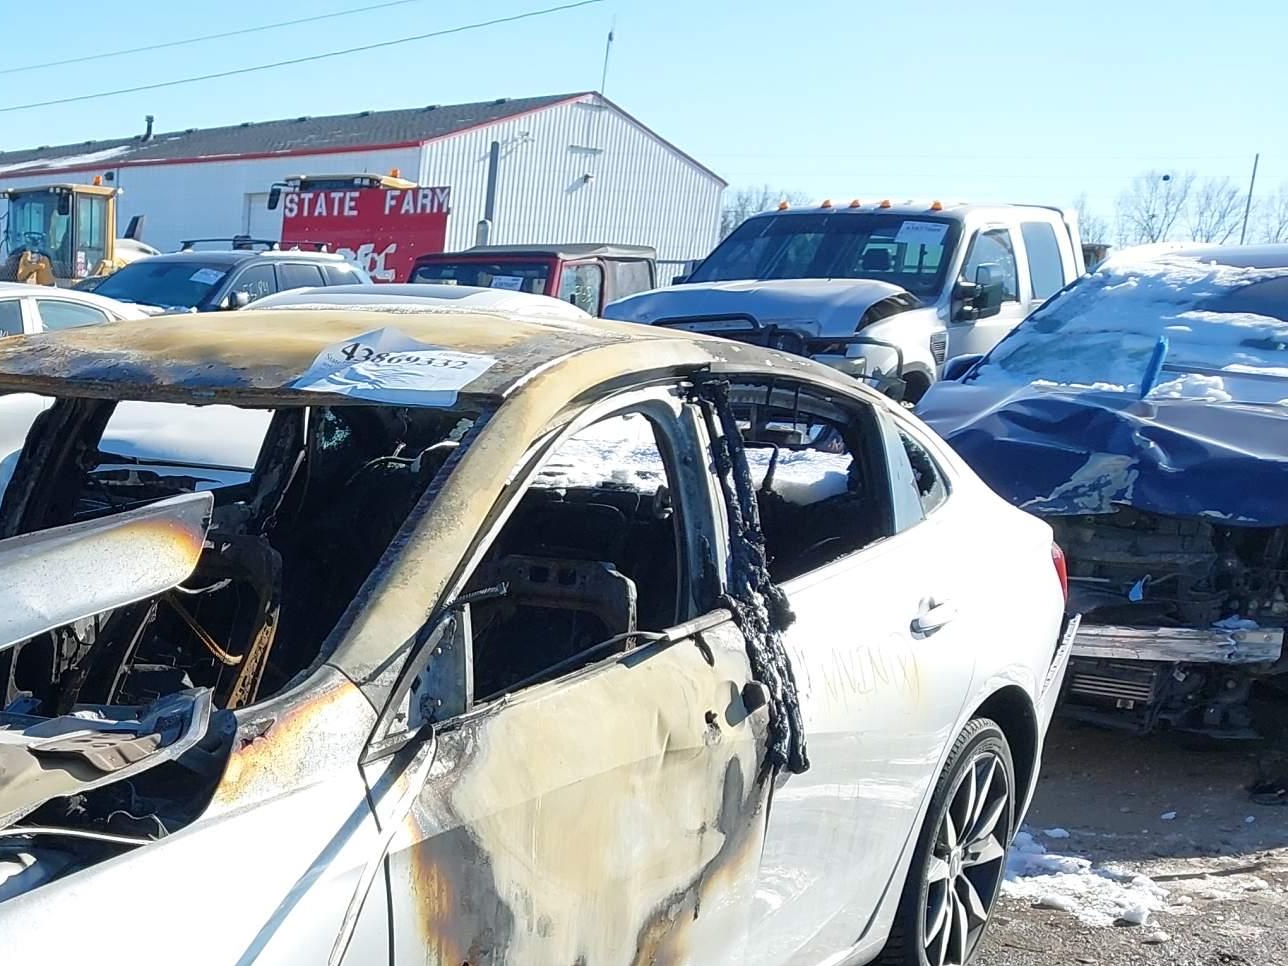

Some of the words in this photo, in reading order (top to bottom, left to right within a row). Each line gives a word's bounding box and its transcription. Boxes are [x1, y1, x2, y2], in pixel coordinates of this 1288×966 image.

[284, 191, 360, 218] STATE
[383, 188, 450, 215] FARM
[340, 342, 468, 370] 43869332
